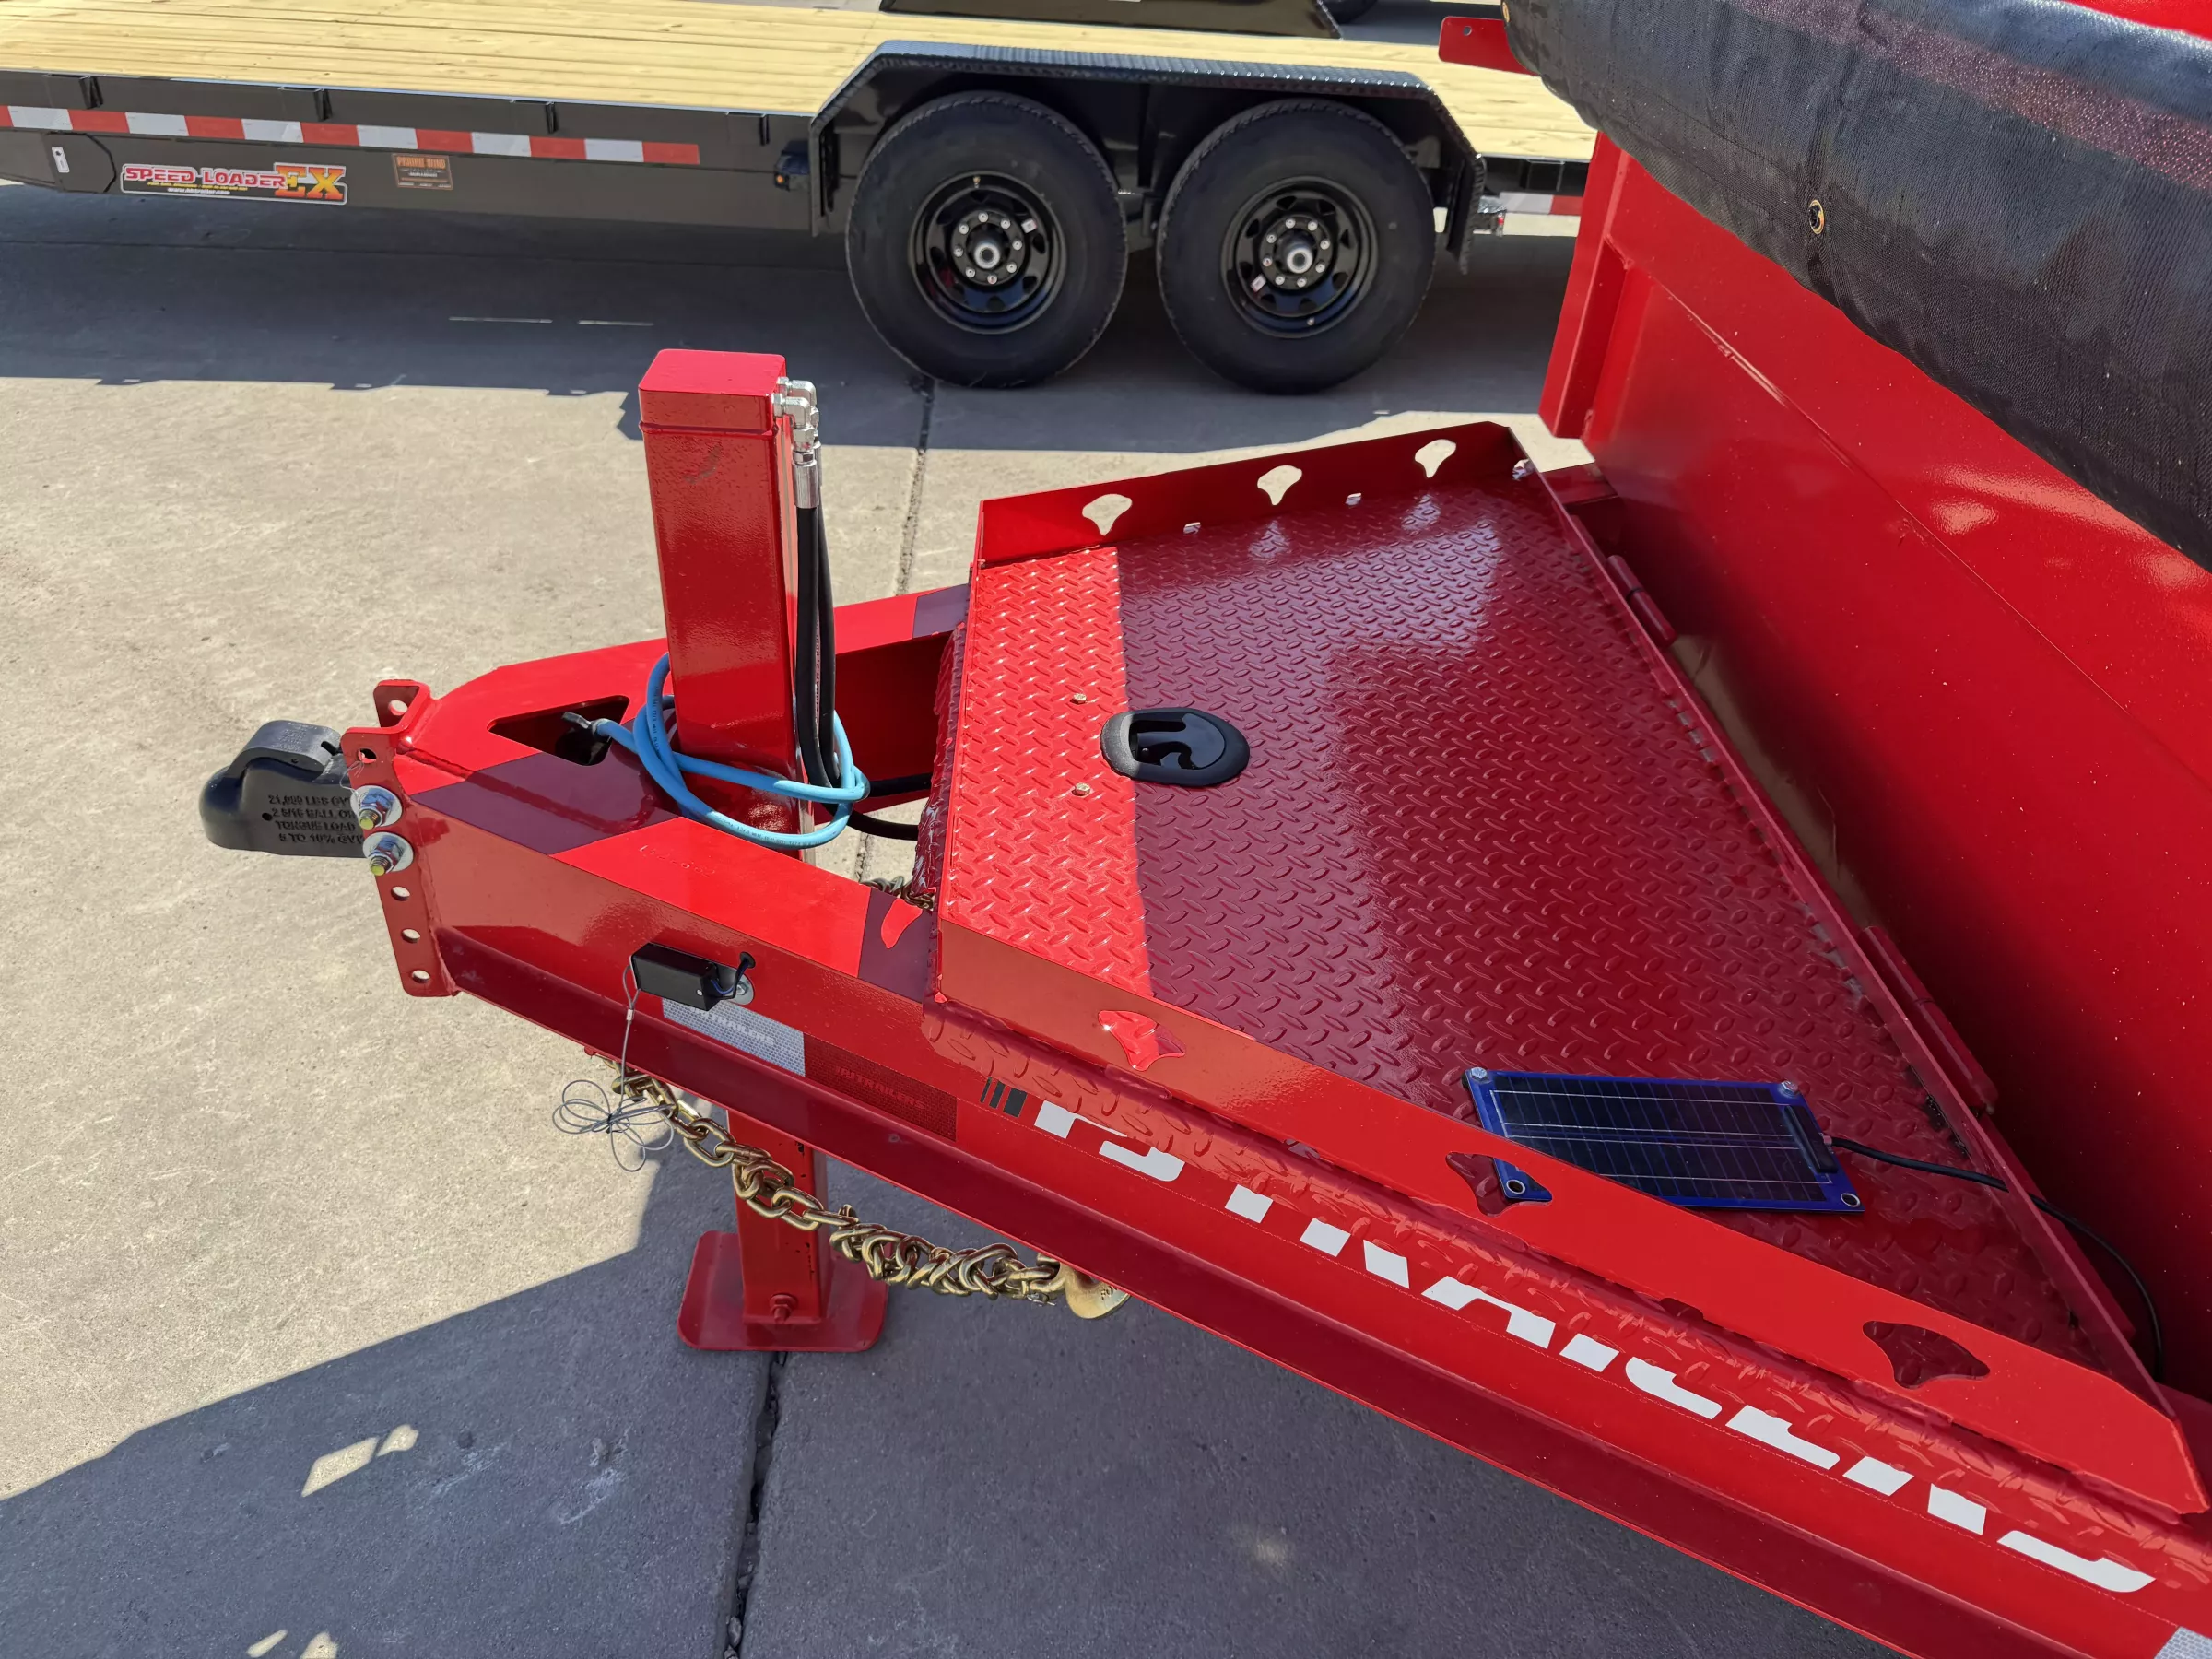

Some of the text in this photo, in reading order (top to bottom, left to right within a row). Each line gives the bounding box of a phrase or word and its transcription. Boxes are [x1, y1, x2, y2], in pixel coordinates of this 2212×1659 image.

[124, 167, 195, 182] SPEED
[203, 170, 288, 189] LOADER
[275, 165, 345, 200] EX
[288, 833, 307, 843] TO
[324, 821, 356, 832] LOAD
[857, 1075, 925, 1110] TRAILERS
